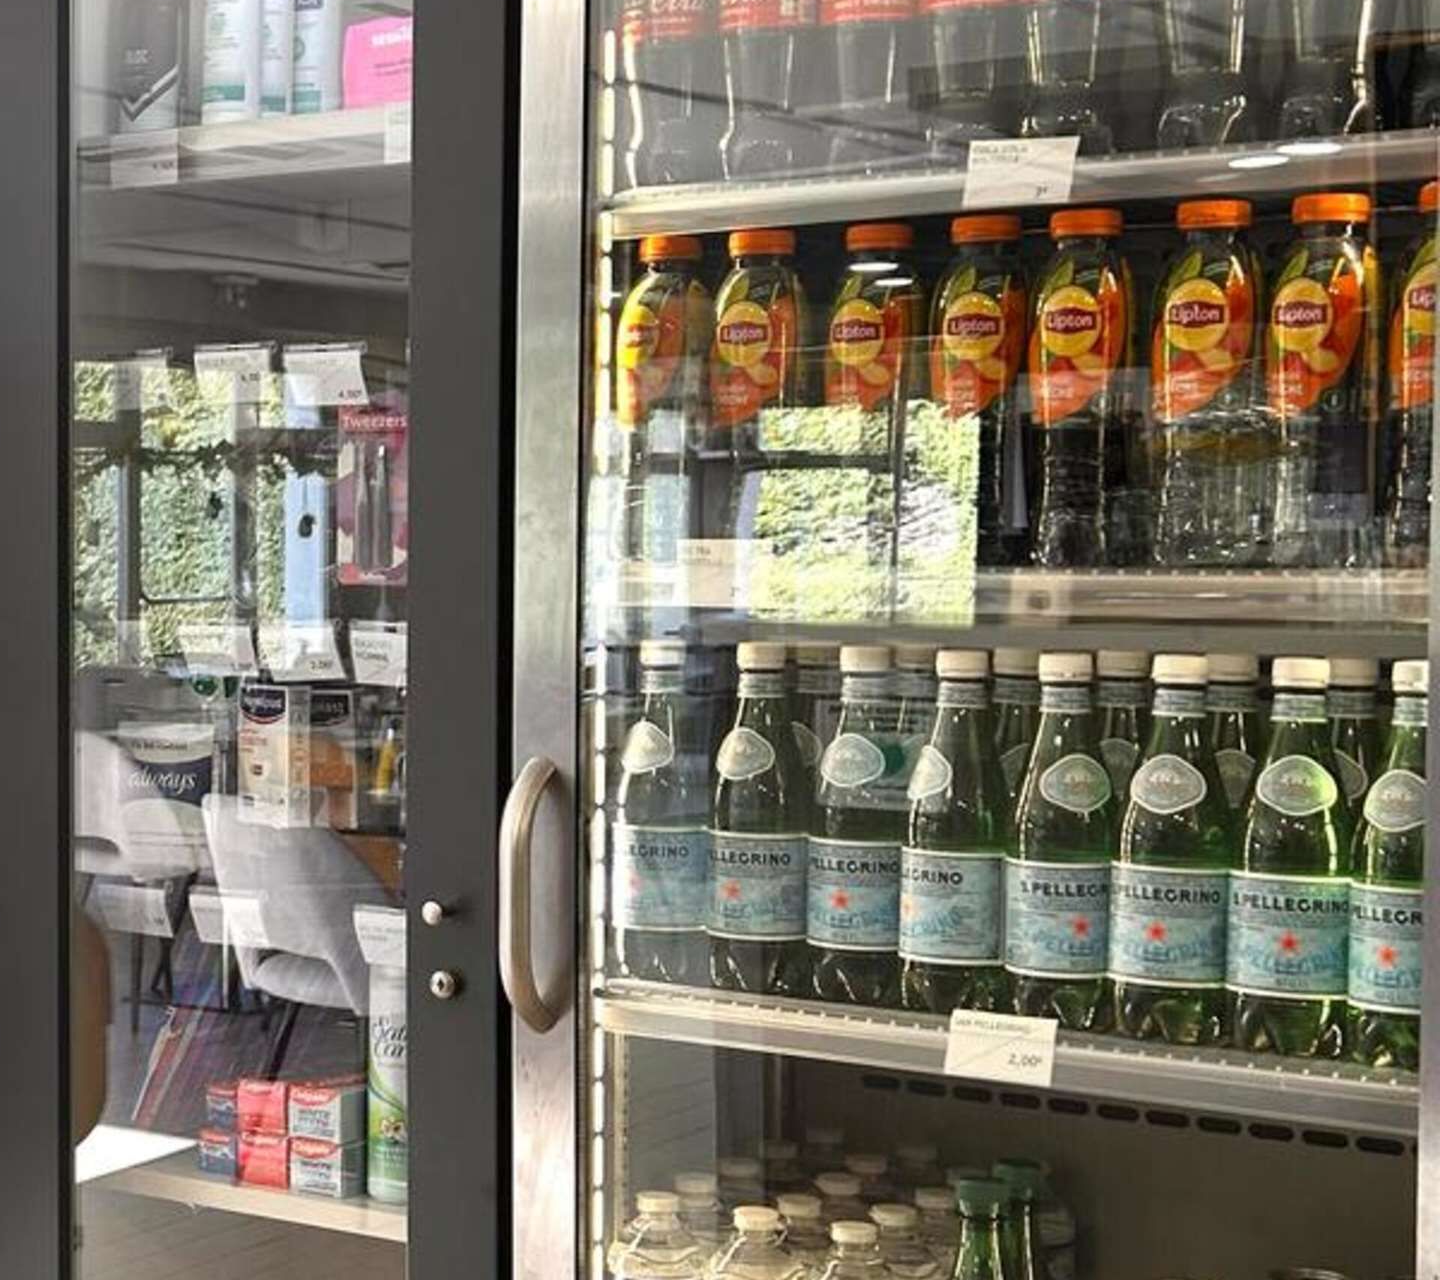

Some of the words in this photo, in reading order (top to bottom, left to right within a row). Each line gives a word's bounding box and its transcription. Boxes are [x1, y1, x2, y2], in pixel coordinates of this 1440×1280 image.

[1046, 308, 1094, 331] Lipton
[1170, 303, 1221, 324] Lipton
[948, 320, 997, 339] Lipton
[128, 765, 198, 795] always
